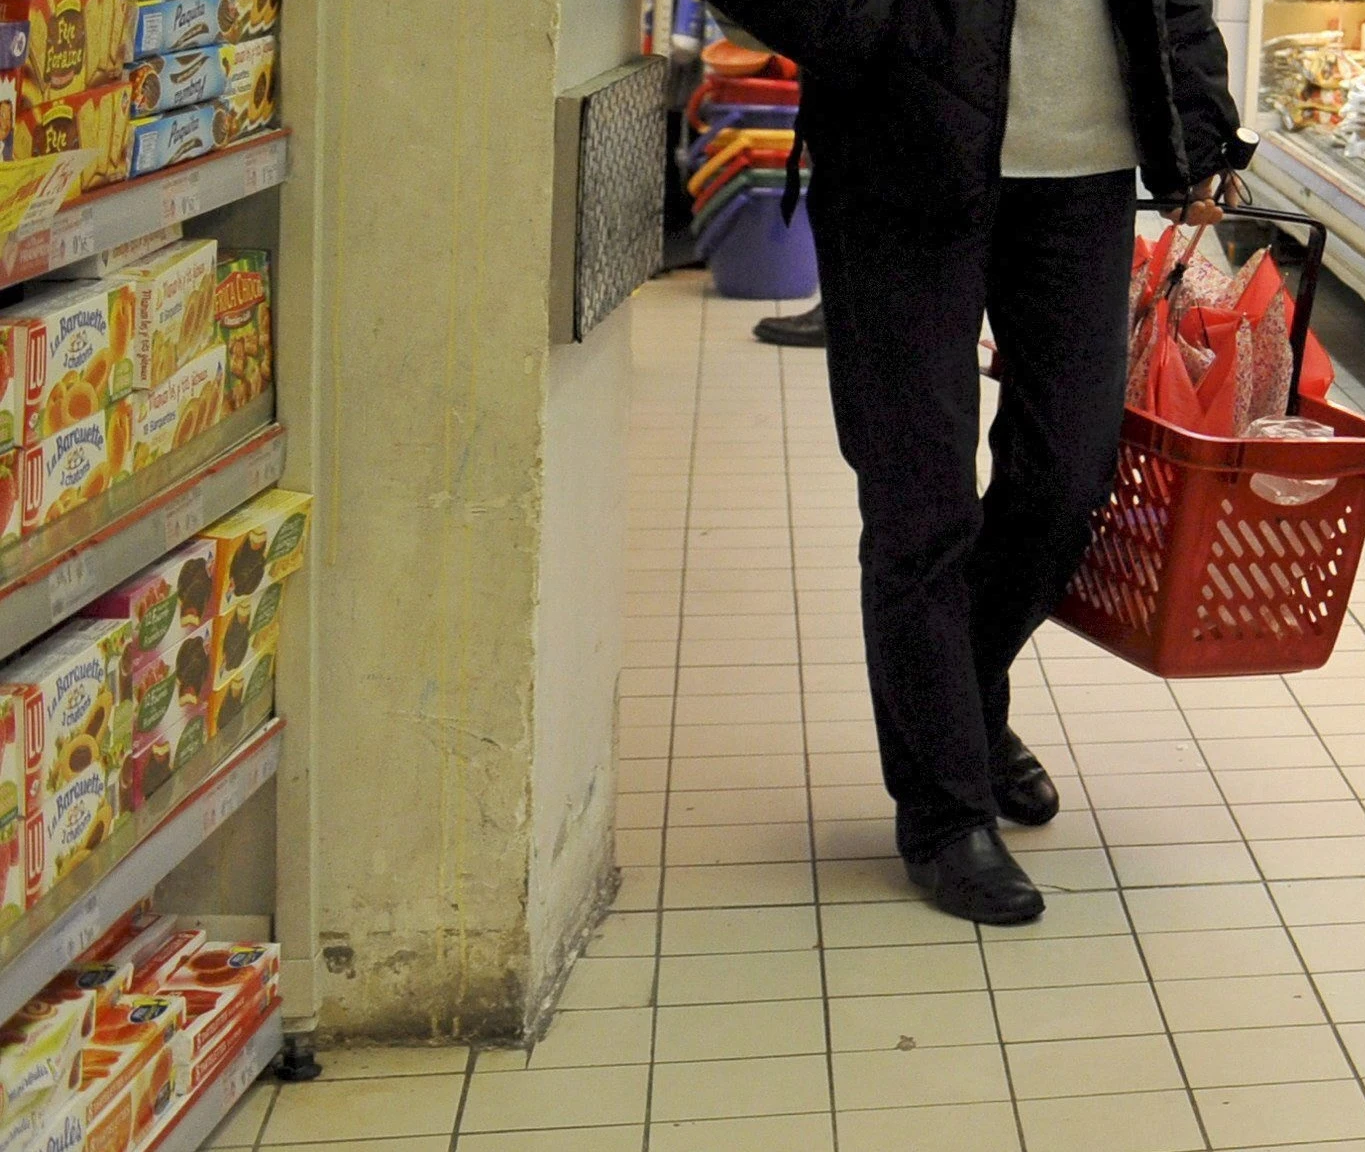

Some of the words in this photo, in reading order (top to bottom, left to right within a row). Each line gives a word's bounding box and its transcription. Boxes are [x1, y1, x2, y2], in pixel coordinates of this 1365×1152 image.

[30, 335, 45, 389] LU
[27, 457, 42, 512] LU
[28, 703, 43, 760] LU
[28, 824, 43, 881] LU
